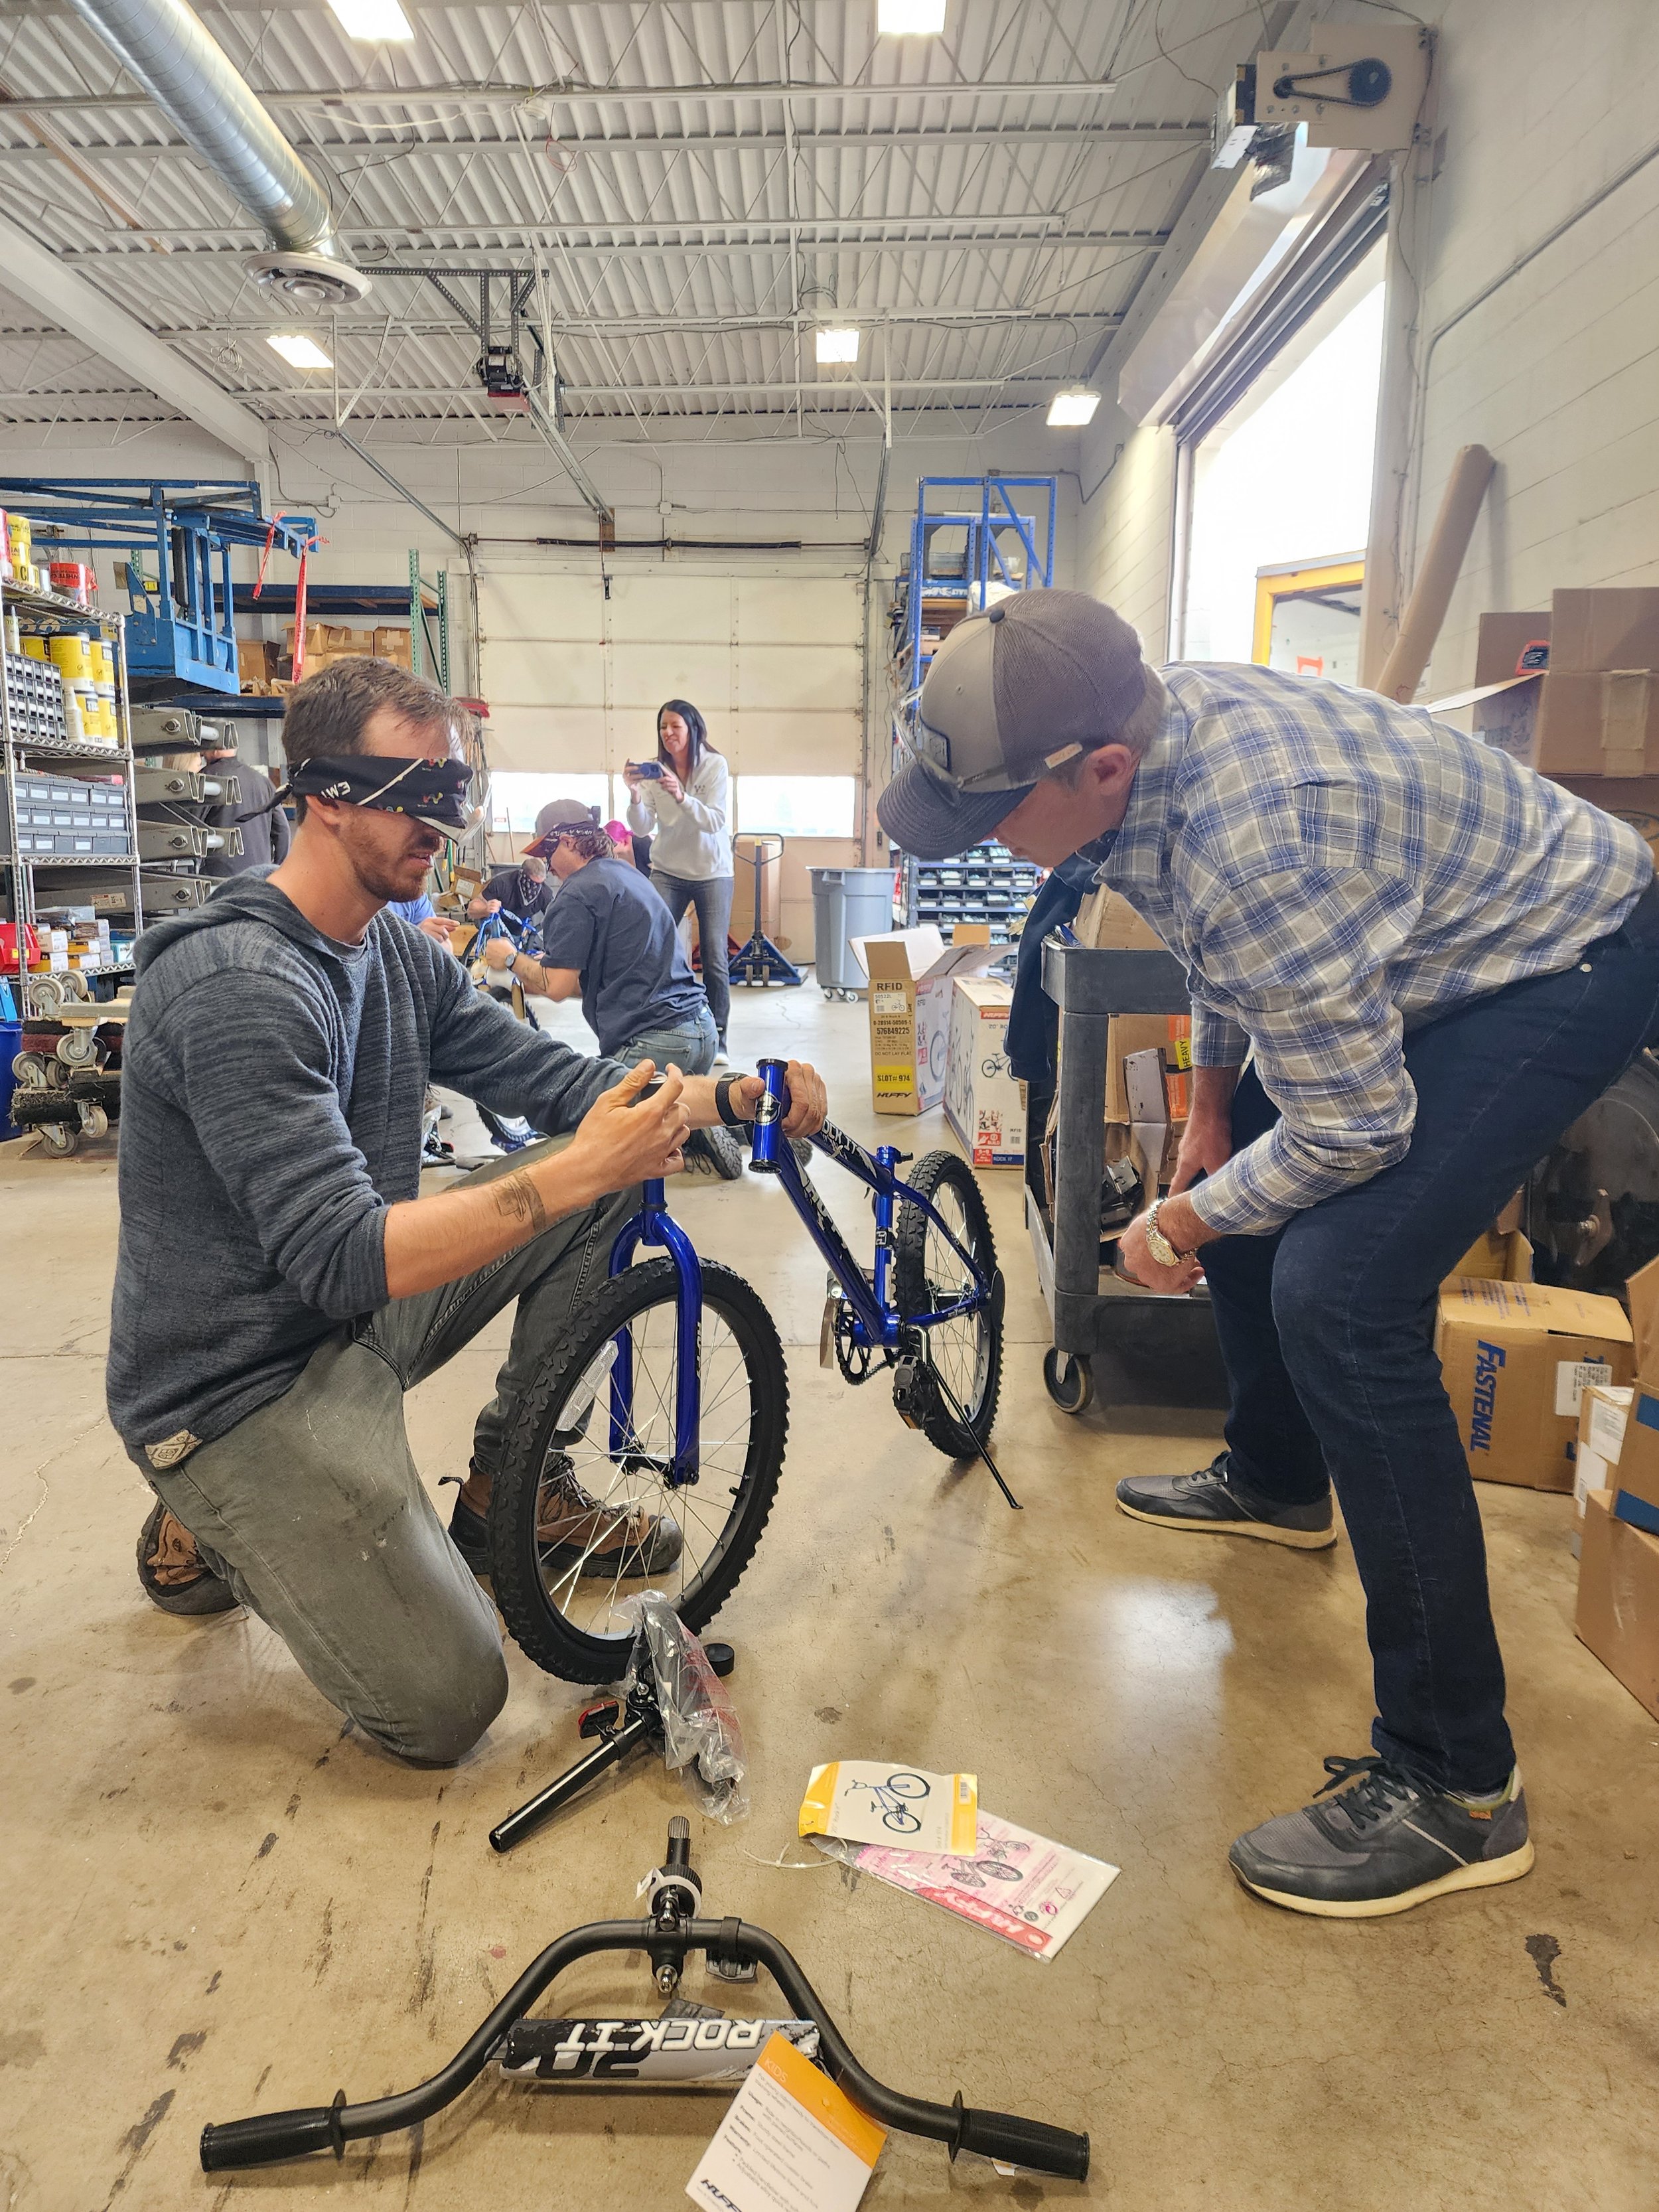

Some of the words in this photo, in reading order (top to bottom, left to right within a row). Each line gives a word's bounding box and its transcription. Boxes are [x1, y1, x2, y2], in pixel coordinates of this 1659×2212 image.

[1179, 1041, 1191, 1067] HEAVY
[821, 1119, 843, 1145] OCK
[843, 1139, 859, 1155] IT
[1470, 1339, 1506, 1452] FASTENAL
[554, 2022, 625, 2052] IT
[630, 2019, 764, 2051] ROCK
[764, 2056, 788, 2083] KIDS
